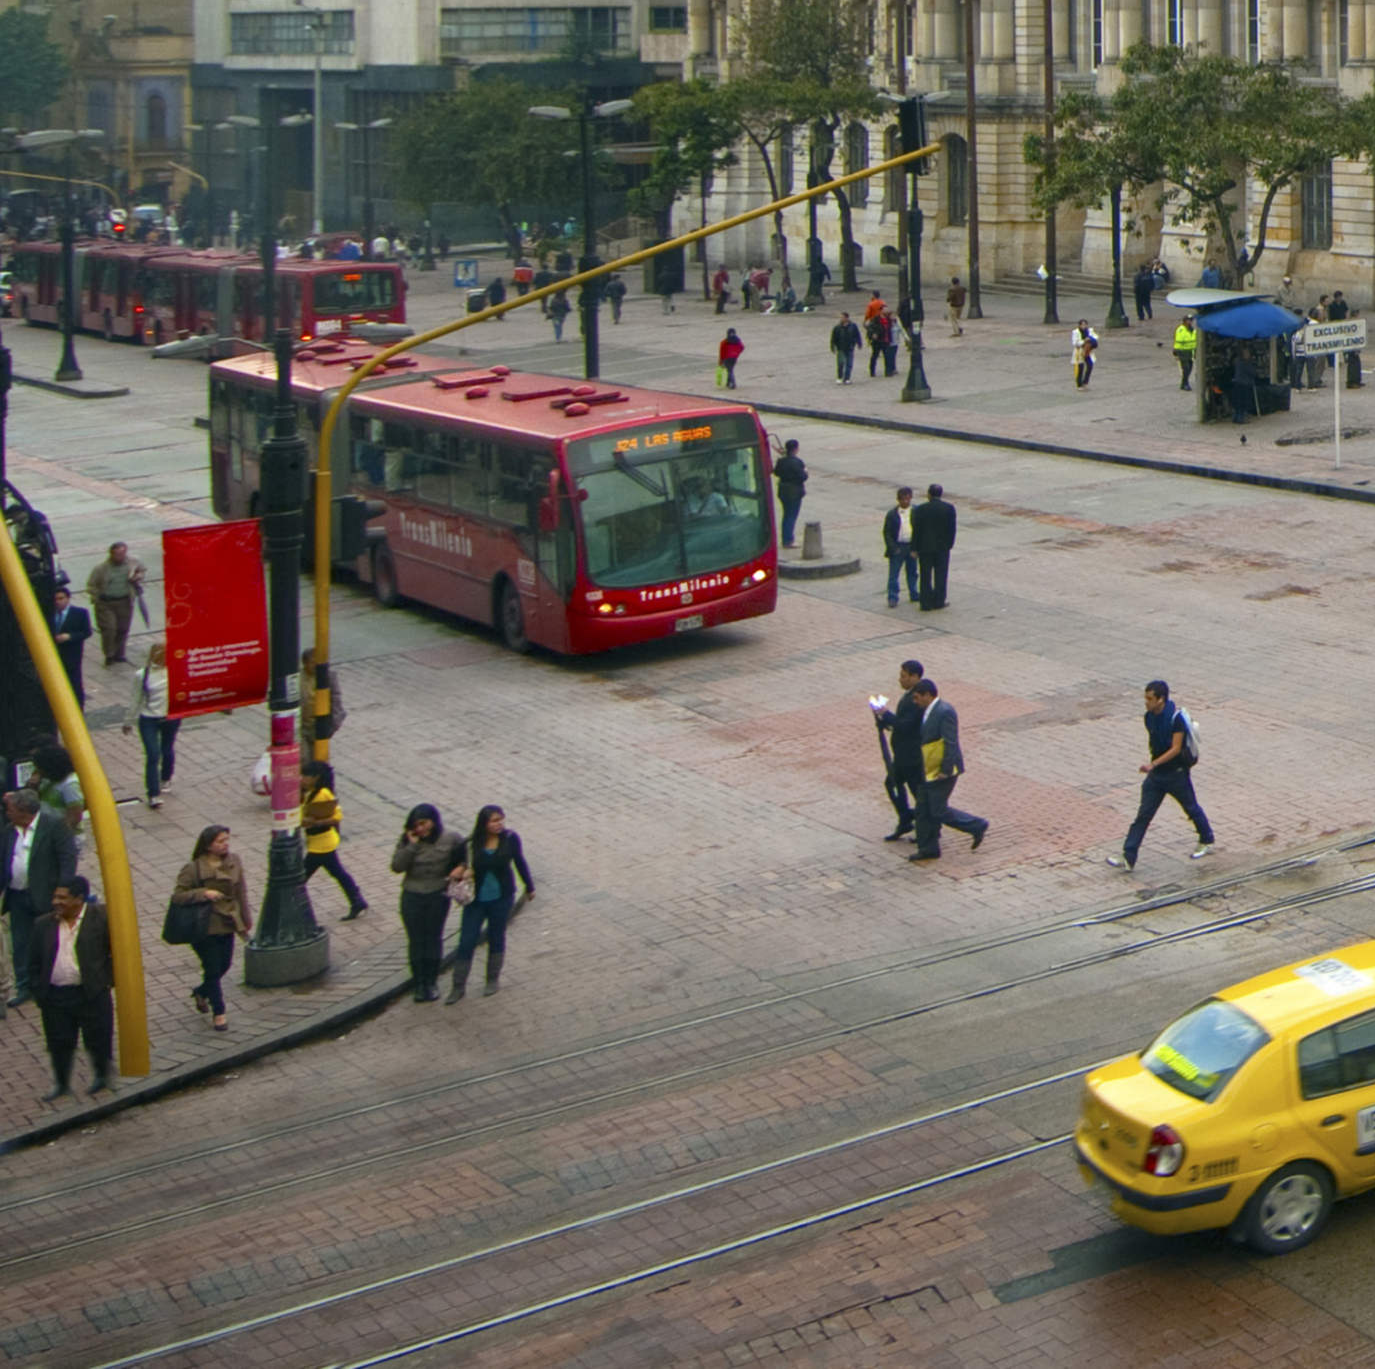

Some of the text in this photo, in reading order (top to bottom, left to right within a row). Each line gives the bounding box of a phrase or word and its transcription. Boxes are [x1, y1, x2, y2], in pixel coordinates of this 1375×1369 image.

[1313, 323, 1358, 338] EXCLUSIVO
[1306, 336, 1365, 352] TRANSMILENIO
[644, 433, 670, 448] LAS
[671, 426, 712, 442] AGUAS
[399, 511, 473, 558] TransMilenio
[640, 574, 730, 602] TransMilenio
